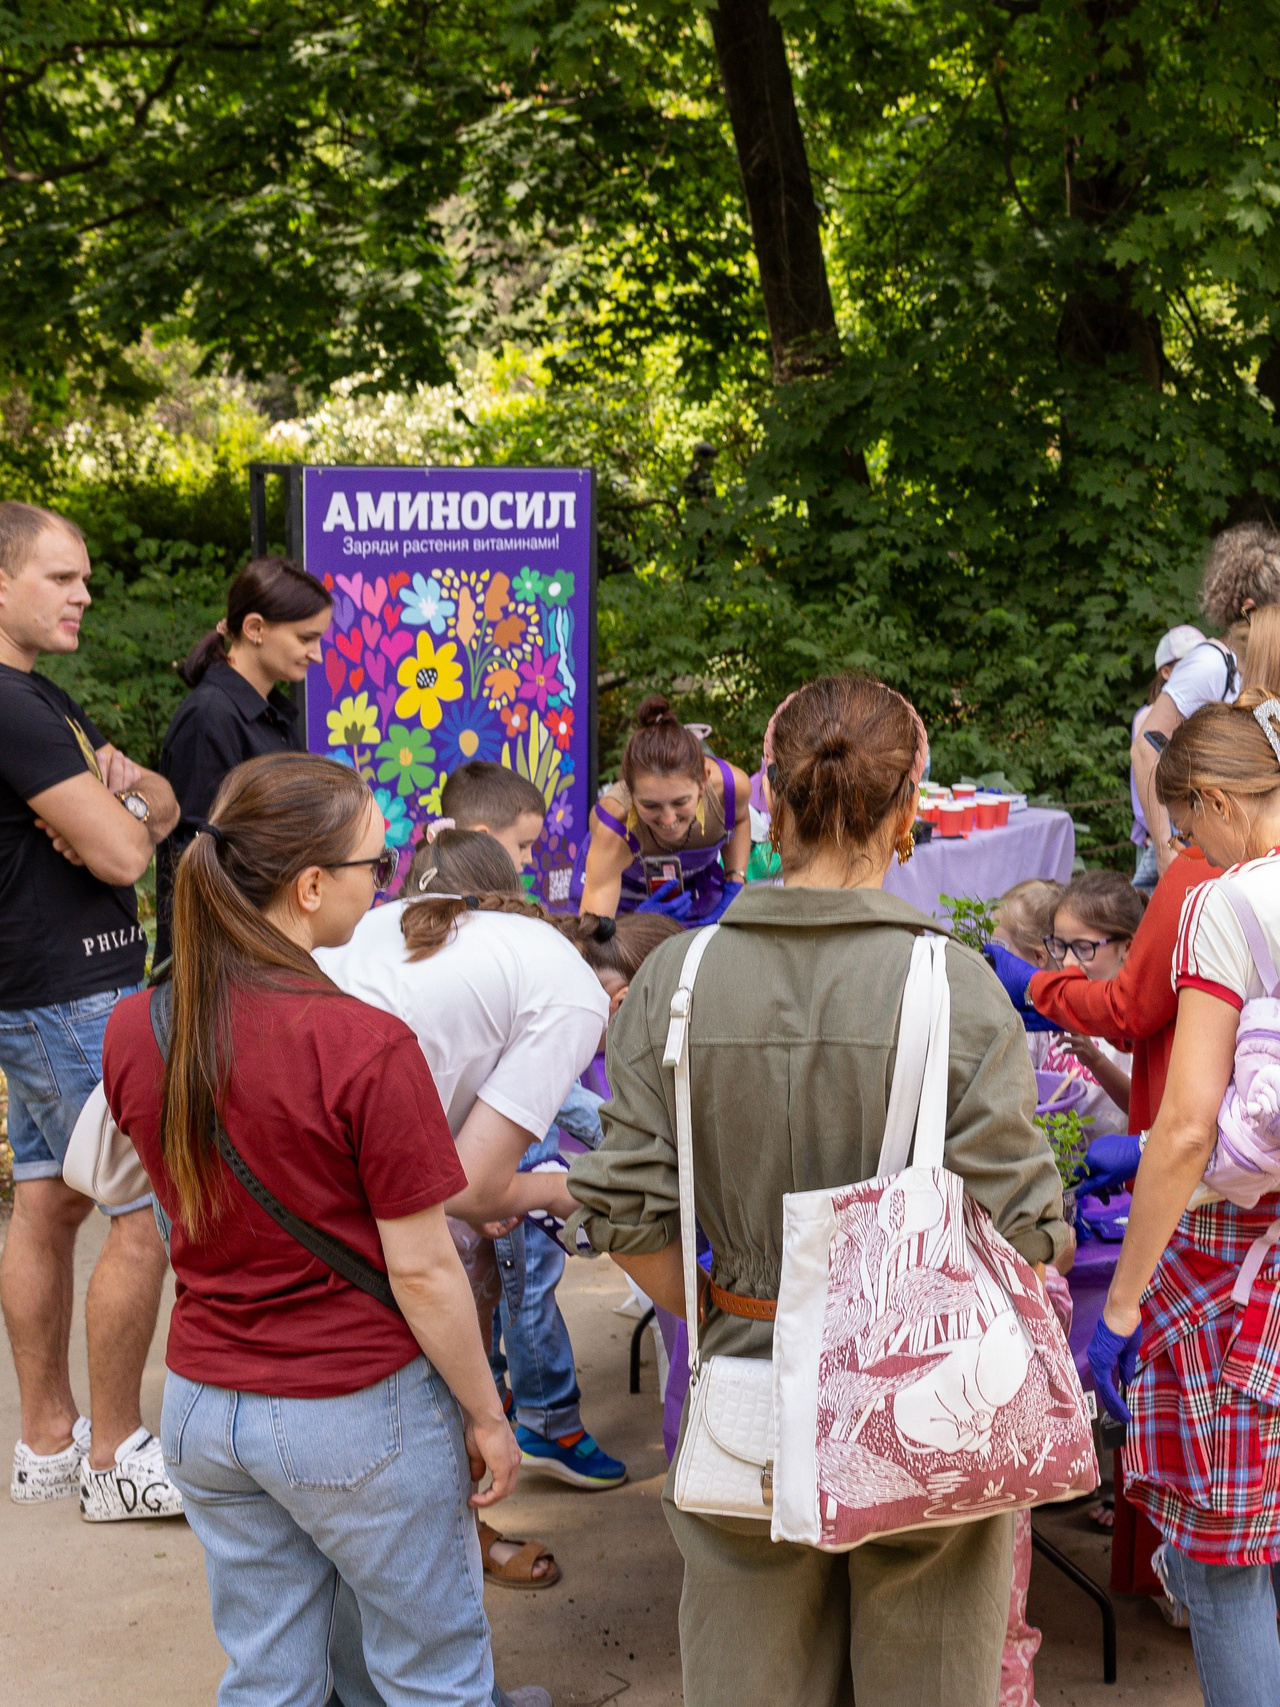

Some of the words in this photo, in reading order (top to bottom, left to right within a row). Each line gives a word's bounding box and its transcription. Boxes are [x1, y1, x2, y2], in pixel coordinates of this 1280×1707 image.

[322, 491, 577, 532] АМИНОСИЛ
[342, 536, 399, 559] Заряди
[403, 537, 470, 558] растения
[472, 533, 560, 552] витаминами!
[116, 1477, 169, 1515] DG
